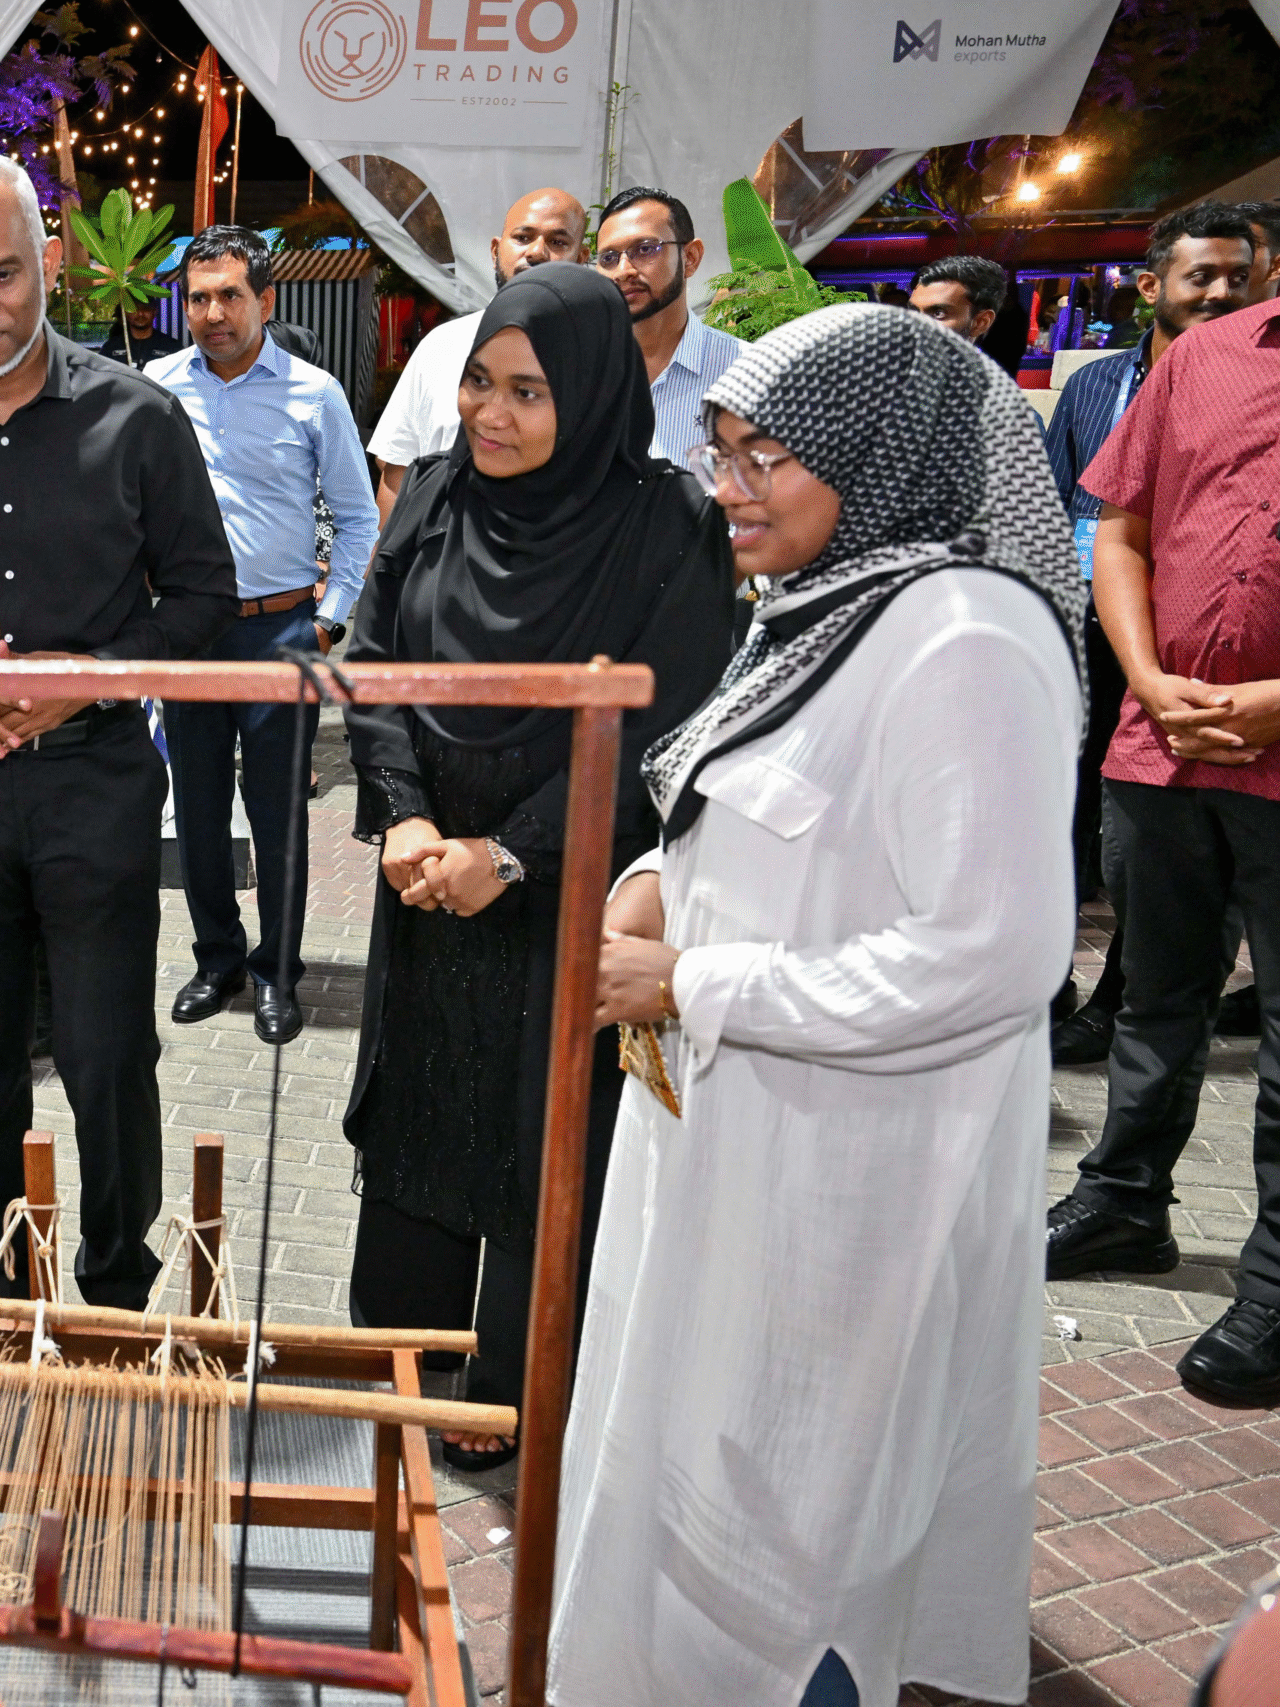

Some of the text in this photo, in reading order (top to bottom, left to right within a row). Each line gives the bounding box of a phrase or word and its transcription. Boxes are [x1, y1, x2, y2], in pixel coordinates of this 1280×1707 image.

[415, 0, 578, 53] LEO
[955, 34, 1046, 47] Mohan Mutha
[954, 50, 1006, 64] exports
[413, 64, 569, 83] TRADING
[461, 96, 517, 106] EST2002
